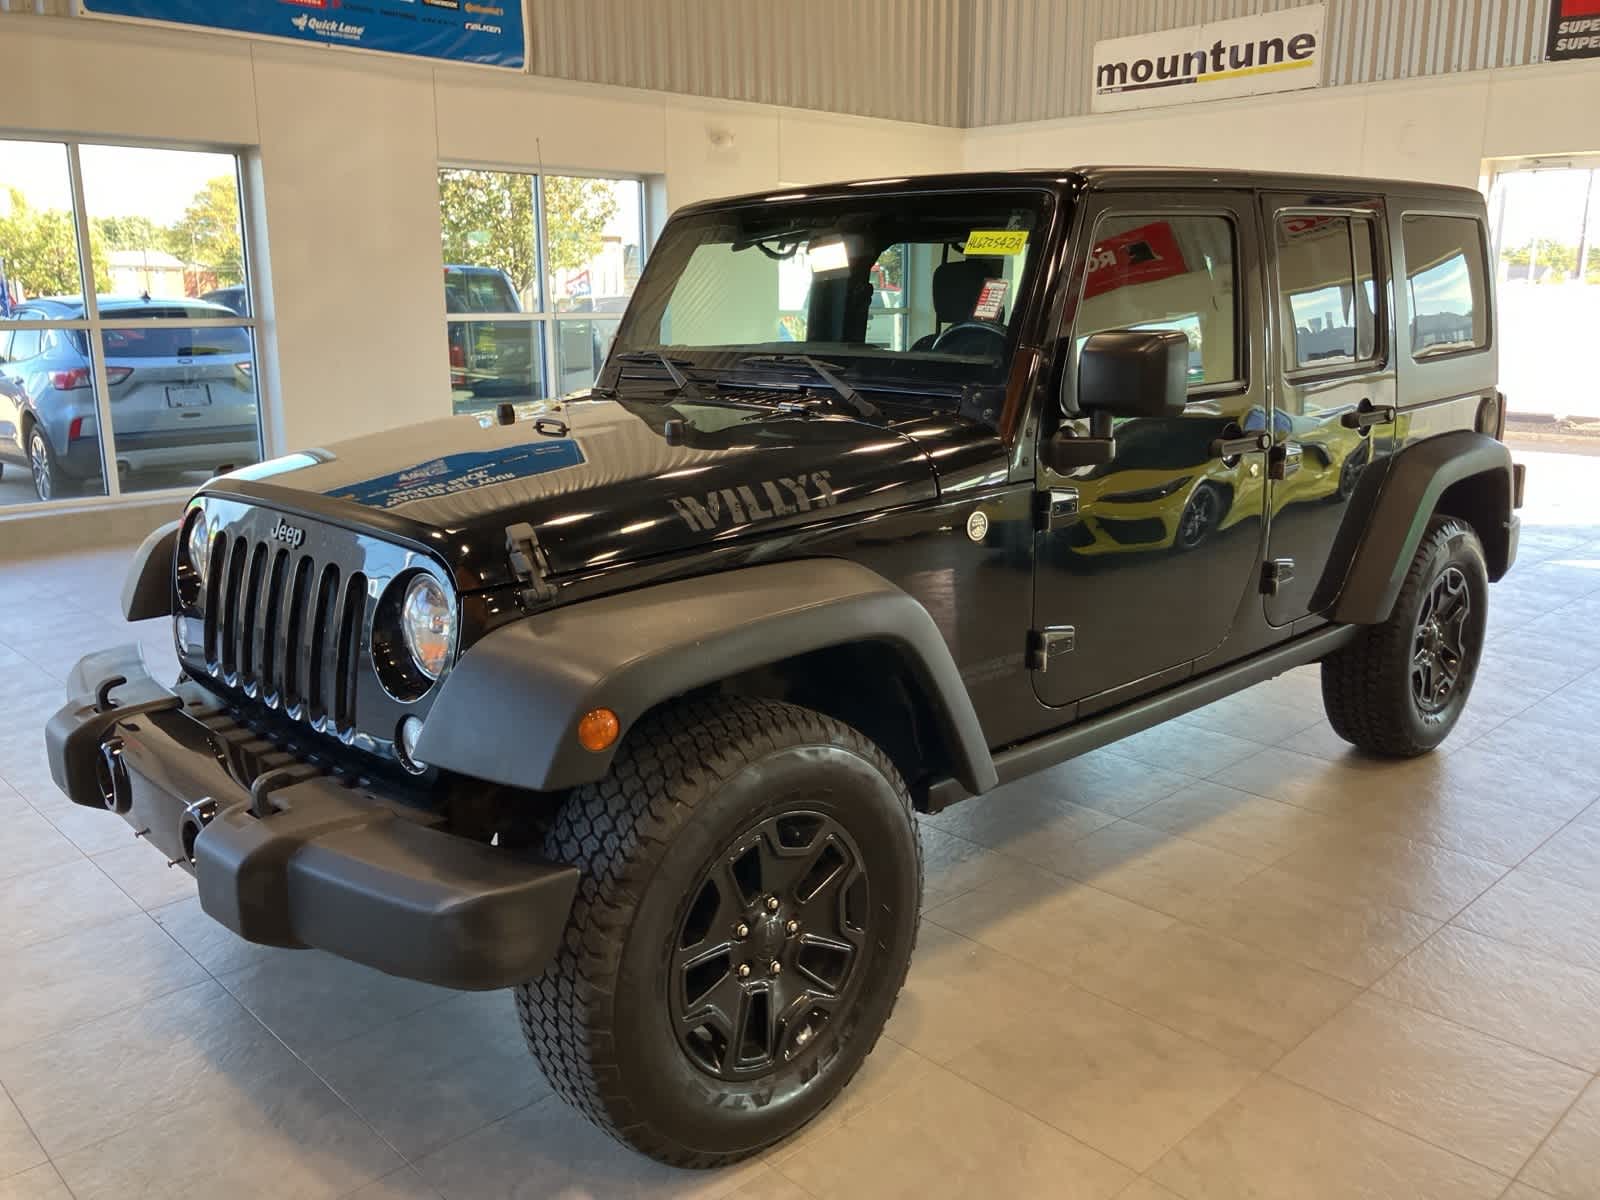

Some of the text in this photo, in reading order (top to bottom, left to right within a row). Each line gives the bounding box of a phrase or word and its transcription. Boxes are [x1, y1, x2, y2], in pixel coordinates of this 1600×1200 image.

[308, 17, 338, 32] Quick
[339, 22, 365, 35] Lane
[1556, 36, 1600, 51] SUPE
[1096, 32, 1317, 88] mountune
[670, 470, 837, 532] WILLYS
[271, 518, 302, 549] Jeep
